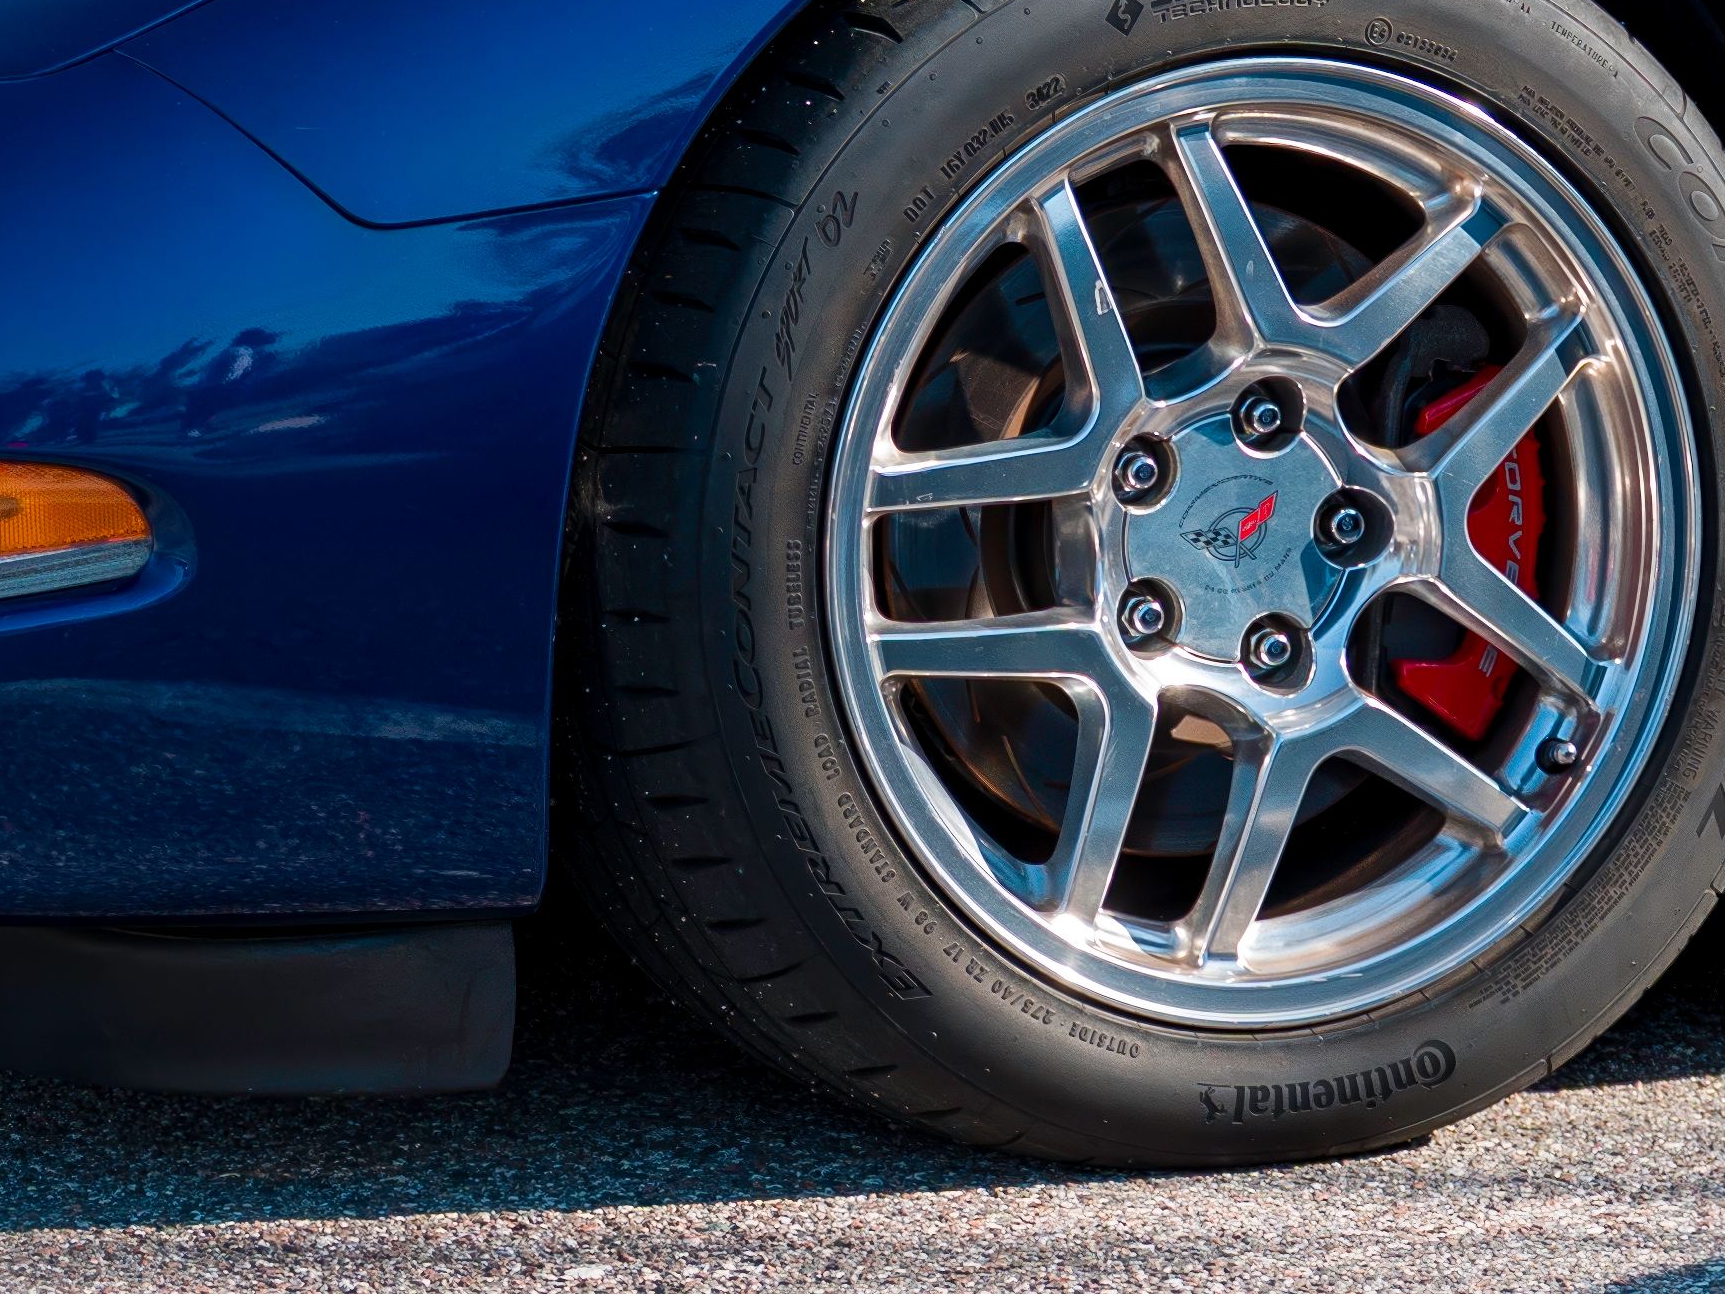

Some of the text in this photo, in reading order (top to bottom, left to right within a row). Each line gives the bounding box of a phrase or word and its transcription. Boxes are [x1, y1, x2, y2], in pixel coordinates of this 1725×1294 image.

[903, 185, 936, 223] DOT
[787, 538, 804, 631] TUBELESS
[792, 647, 822, 719] RADIAL
[813, 732, 842, 781] LOAD
[836, 791, 897, 885] STANDARD
[942, 941, 964, 963] 17
[1234, 1038, 1457, 1123] Continental
